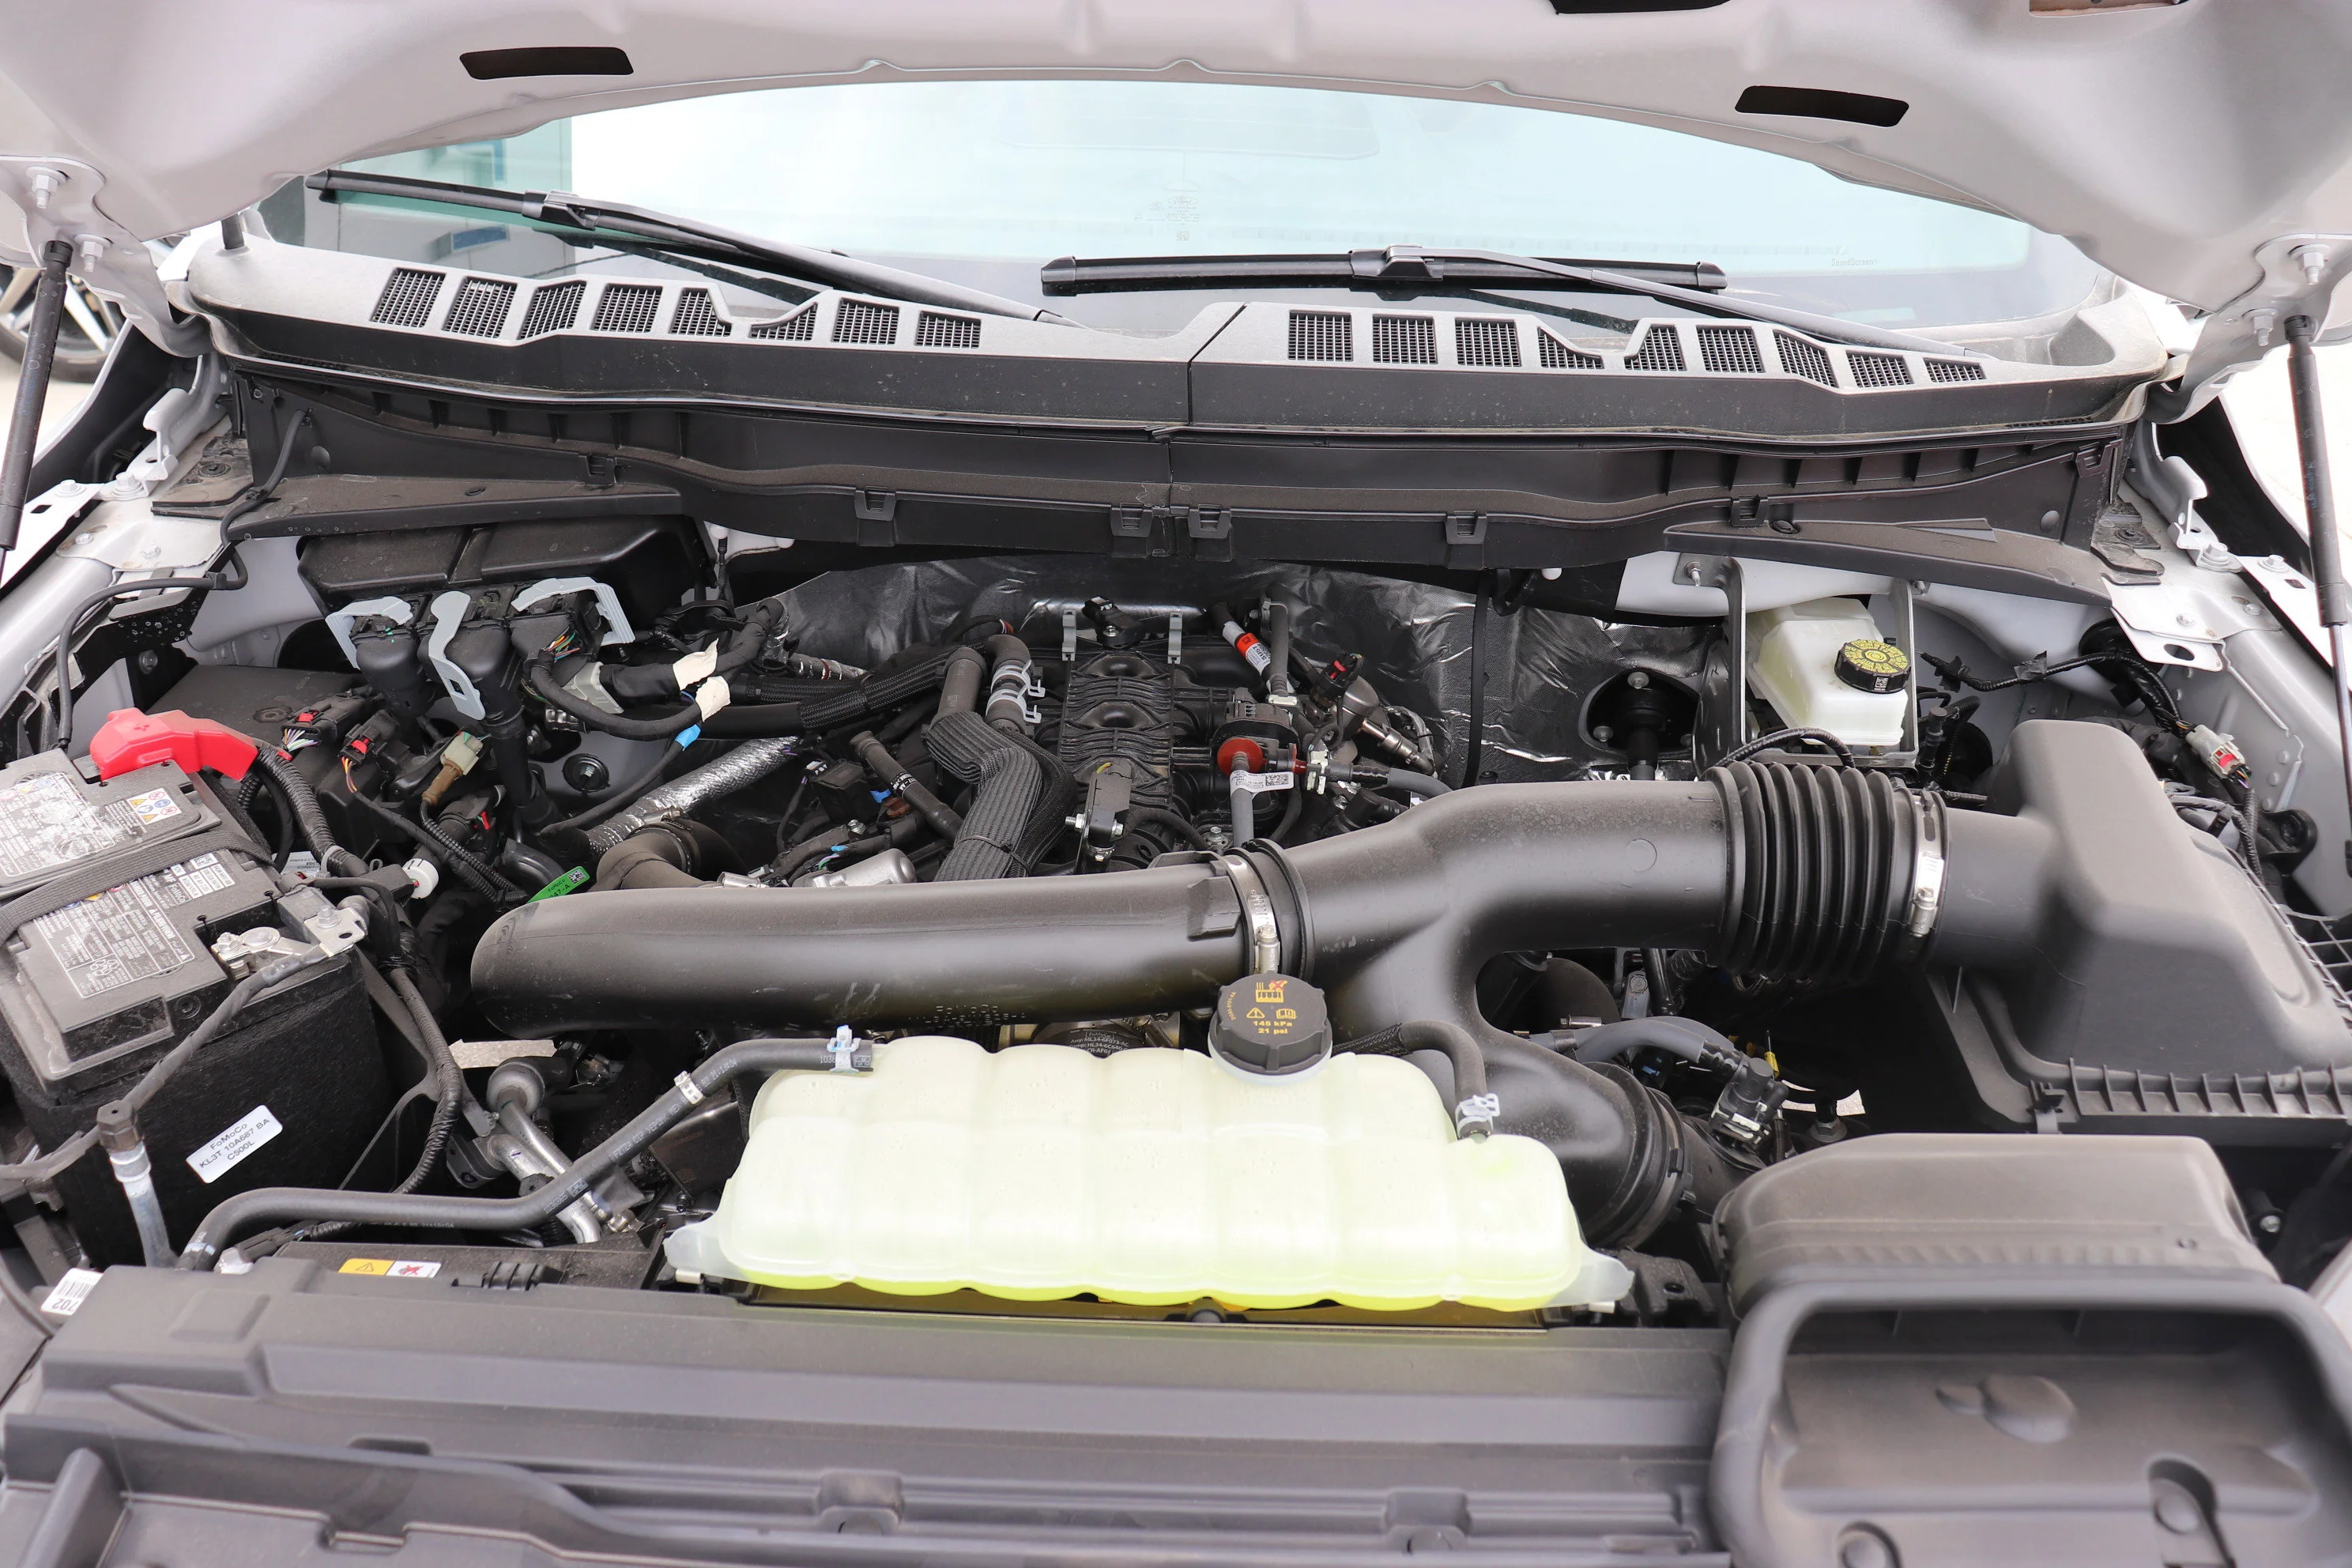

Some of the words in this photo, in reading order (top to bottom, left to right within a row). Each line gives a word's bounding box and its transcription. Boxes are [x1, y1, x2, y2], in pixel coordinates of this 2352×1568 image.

[548, 880, 566, 892] FoMoCo
[199, 1150, 222, 1168] KL3T
[224, 1128, 254, 1152] 10A687
[255, 1118, 270, 1129] BA
[210, 1123, 247, 1150] FoMoCo
[227, 1140, 255, 1161] C500L
